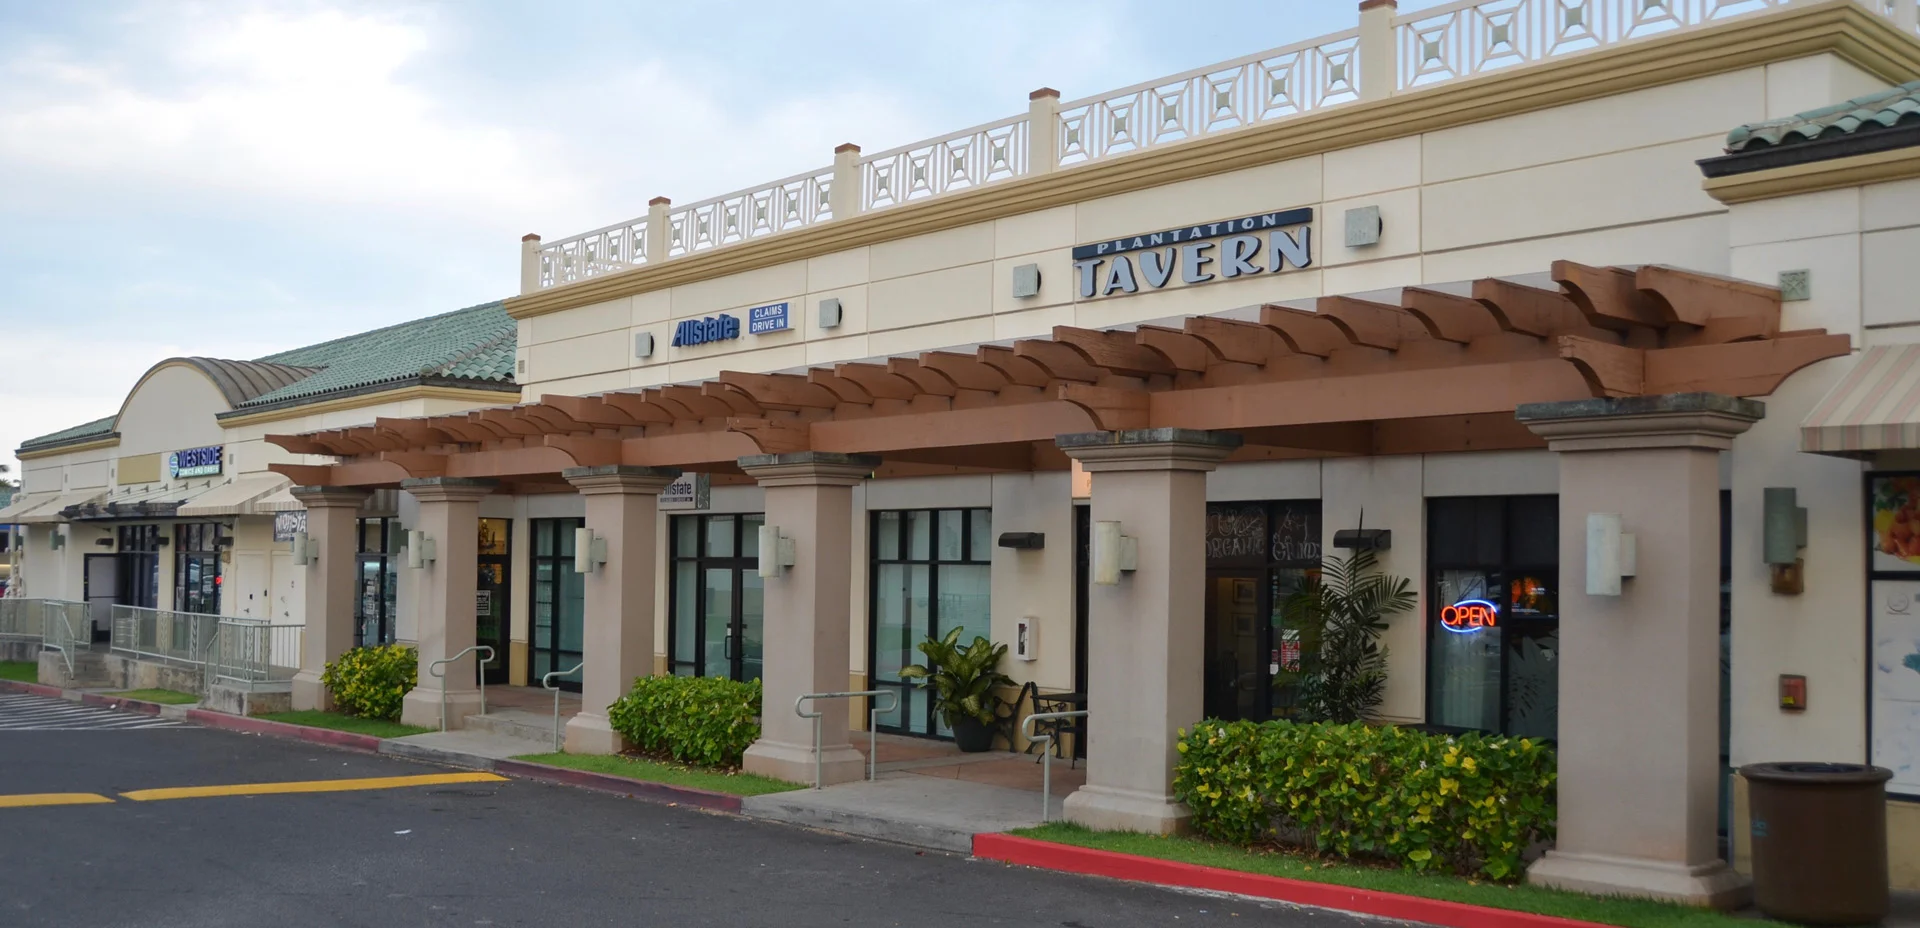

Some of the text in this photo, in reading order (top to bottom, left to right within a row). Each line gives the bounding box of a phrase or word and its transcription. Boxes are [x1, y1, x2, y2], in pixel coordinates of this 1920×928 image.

[1097, 213, 1276, 254] PLANTATION
[1073, 225, 1312, 298] TAVERN
[754, 304, 783, 318] CLAIMS
[671, 314, 738, 347] Allstate
[752, 318, 785, 332] DRIVE IN
[179, 446, 221, 467] WESTSIDE
[1441, 605, 1496, 627] OPEN
